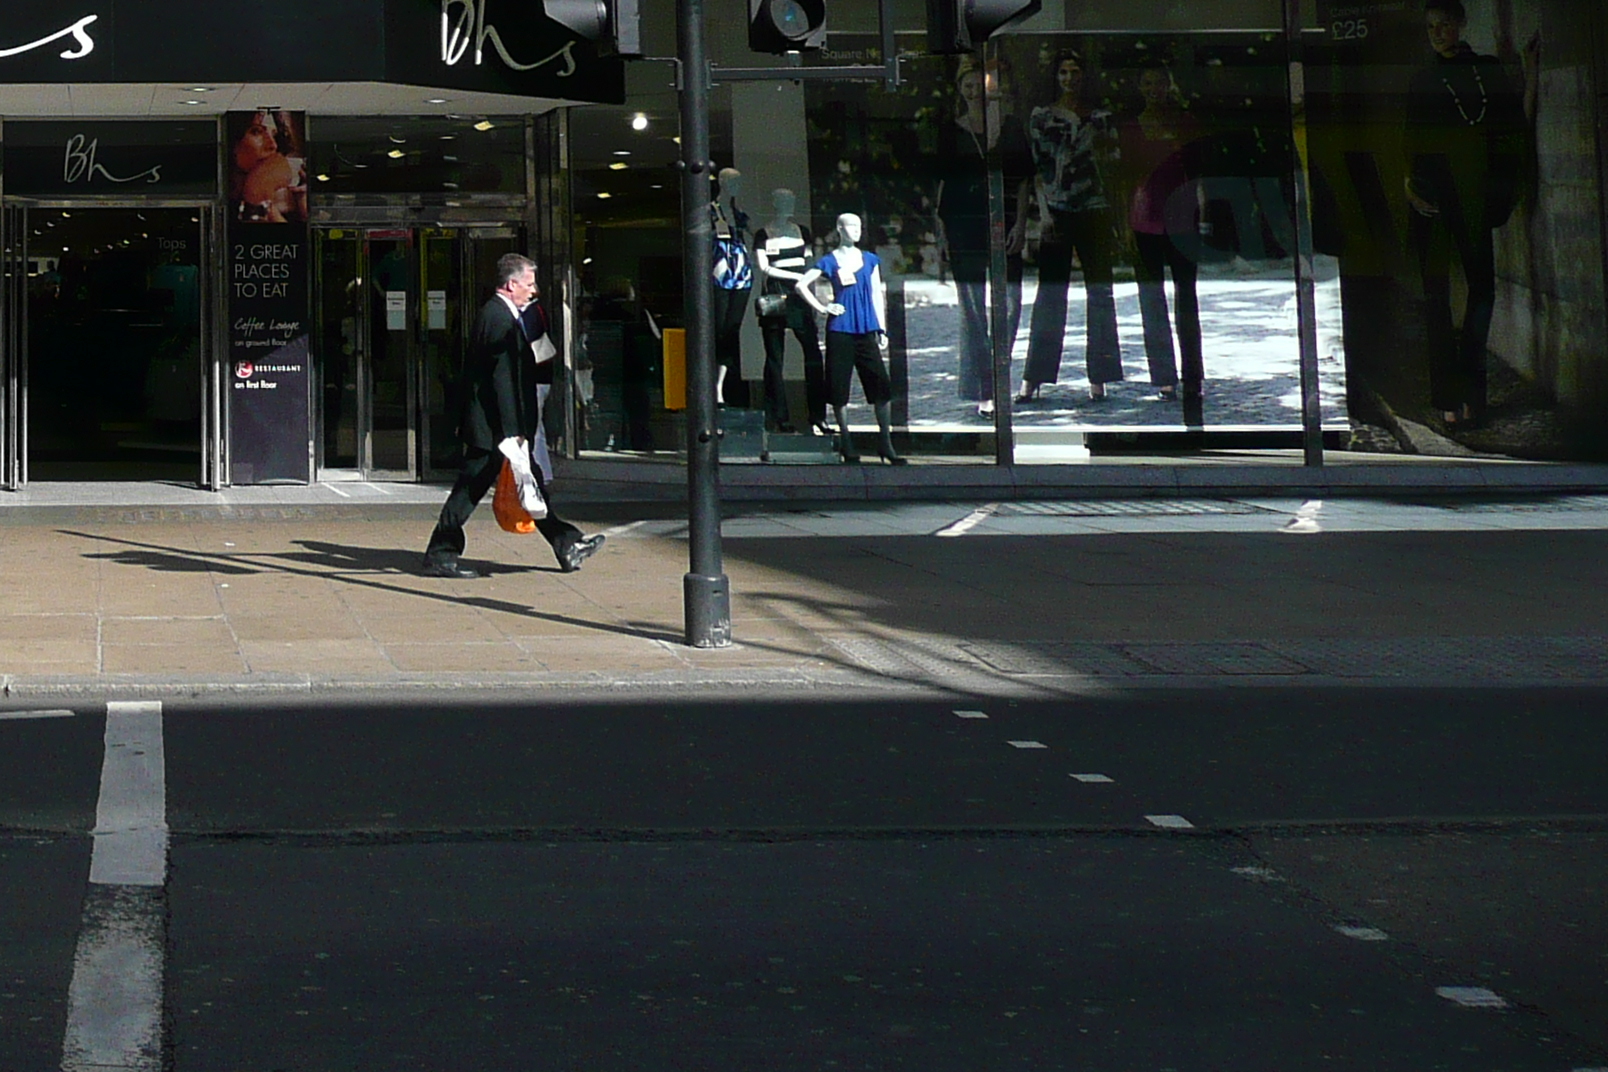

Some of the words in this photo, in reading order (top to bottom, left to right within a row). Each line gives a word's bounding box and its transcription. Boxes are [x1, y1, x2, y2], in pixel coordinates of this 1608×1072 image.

[1332, 18, 1369, 40] £25
[64, 134, 162, 184] Bhs
[156, 236, 187, 251] Tops
[234, 244, 244, 260] 2
[250, 244, 299, 260] GREAT
[234, 263, 290, 279] PLACES
[234, 282, 258, 298] TO
[262, 282, 289, 298] EAT
[234, 317, 265, 337] Coffee
[269, 318, 300, 338] Lounge
[245, 338, 270, 348] ground
[271, 338, 287, 346] floor
